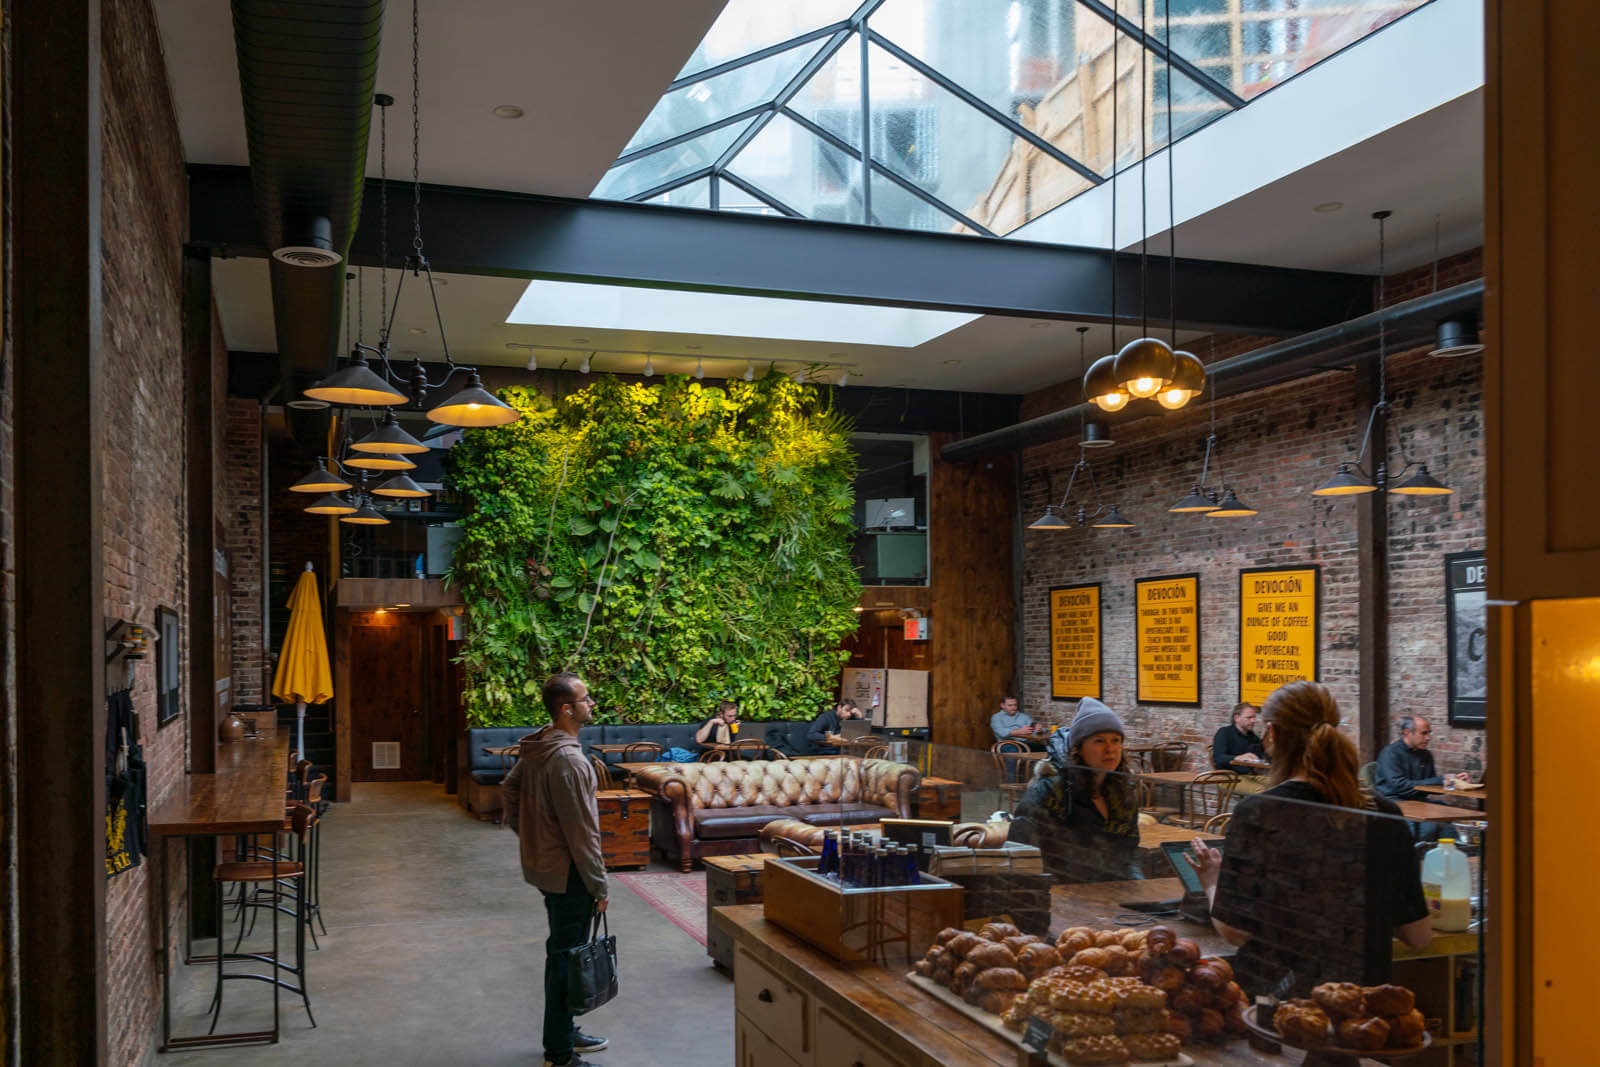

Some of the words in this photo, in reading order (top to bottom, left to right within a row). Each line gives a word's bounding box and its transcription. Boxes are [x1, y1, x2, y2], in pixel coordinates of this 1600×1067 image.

[1255, 576, 1301, 593] DEVOCIÓN
[1147, 583, 1186, 600] DEVOCIÓN
[1257, 602, 1272, 612] GIVE
[1274, 602, 1285, 612] ME
[1246, 616, 1268, 626] OUNCE
[1271, 616, 1282, 626] OF
[1266, 631, 1288, 640] GOOD
[1256, 658, 1263, 668] TO
[1267, 659, 1298, 670] SWEETEN
